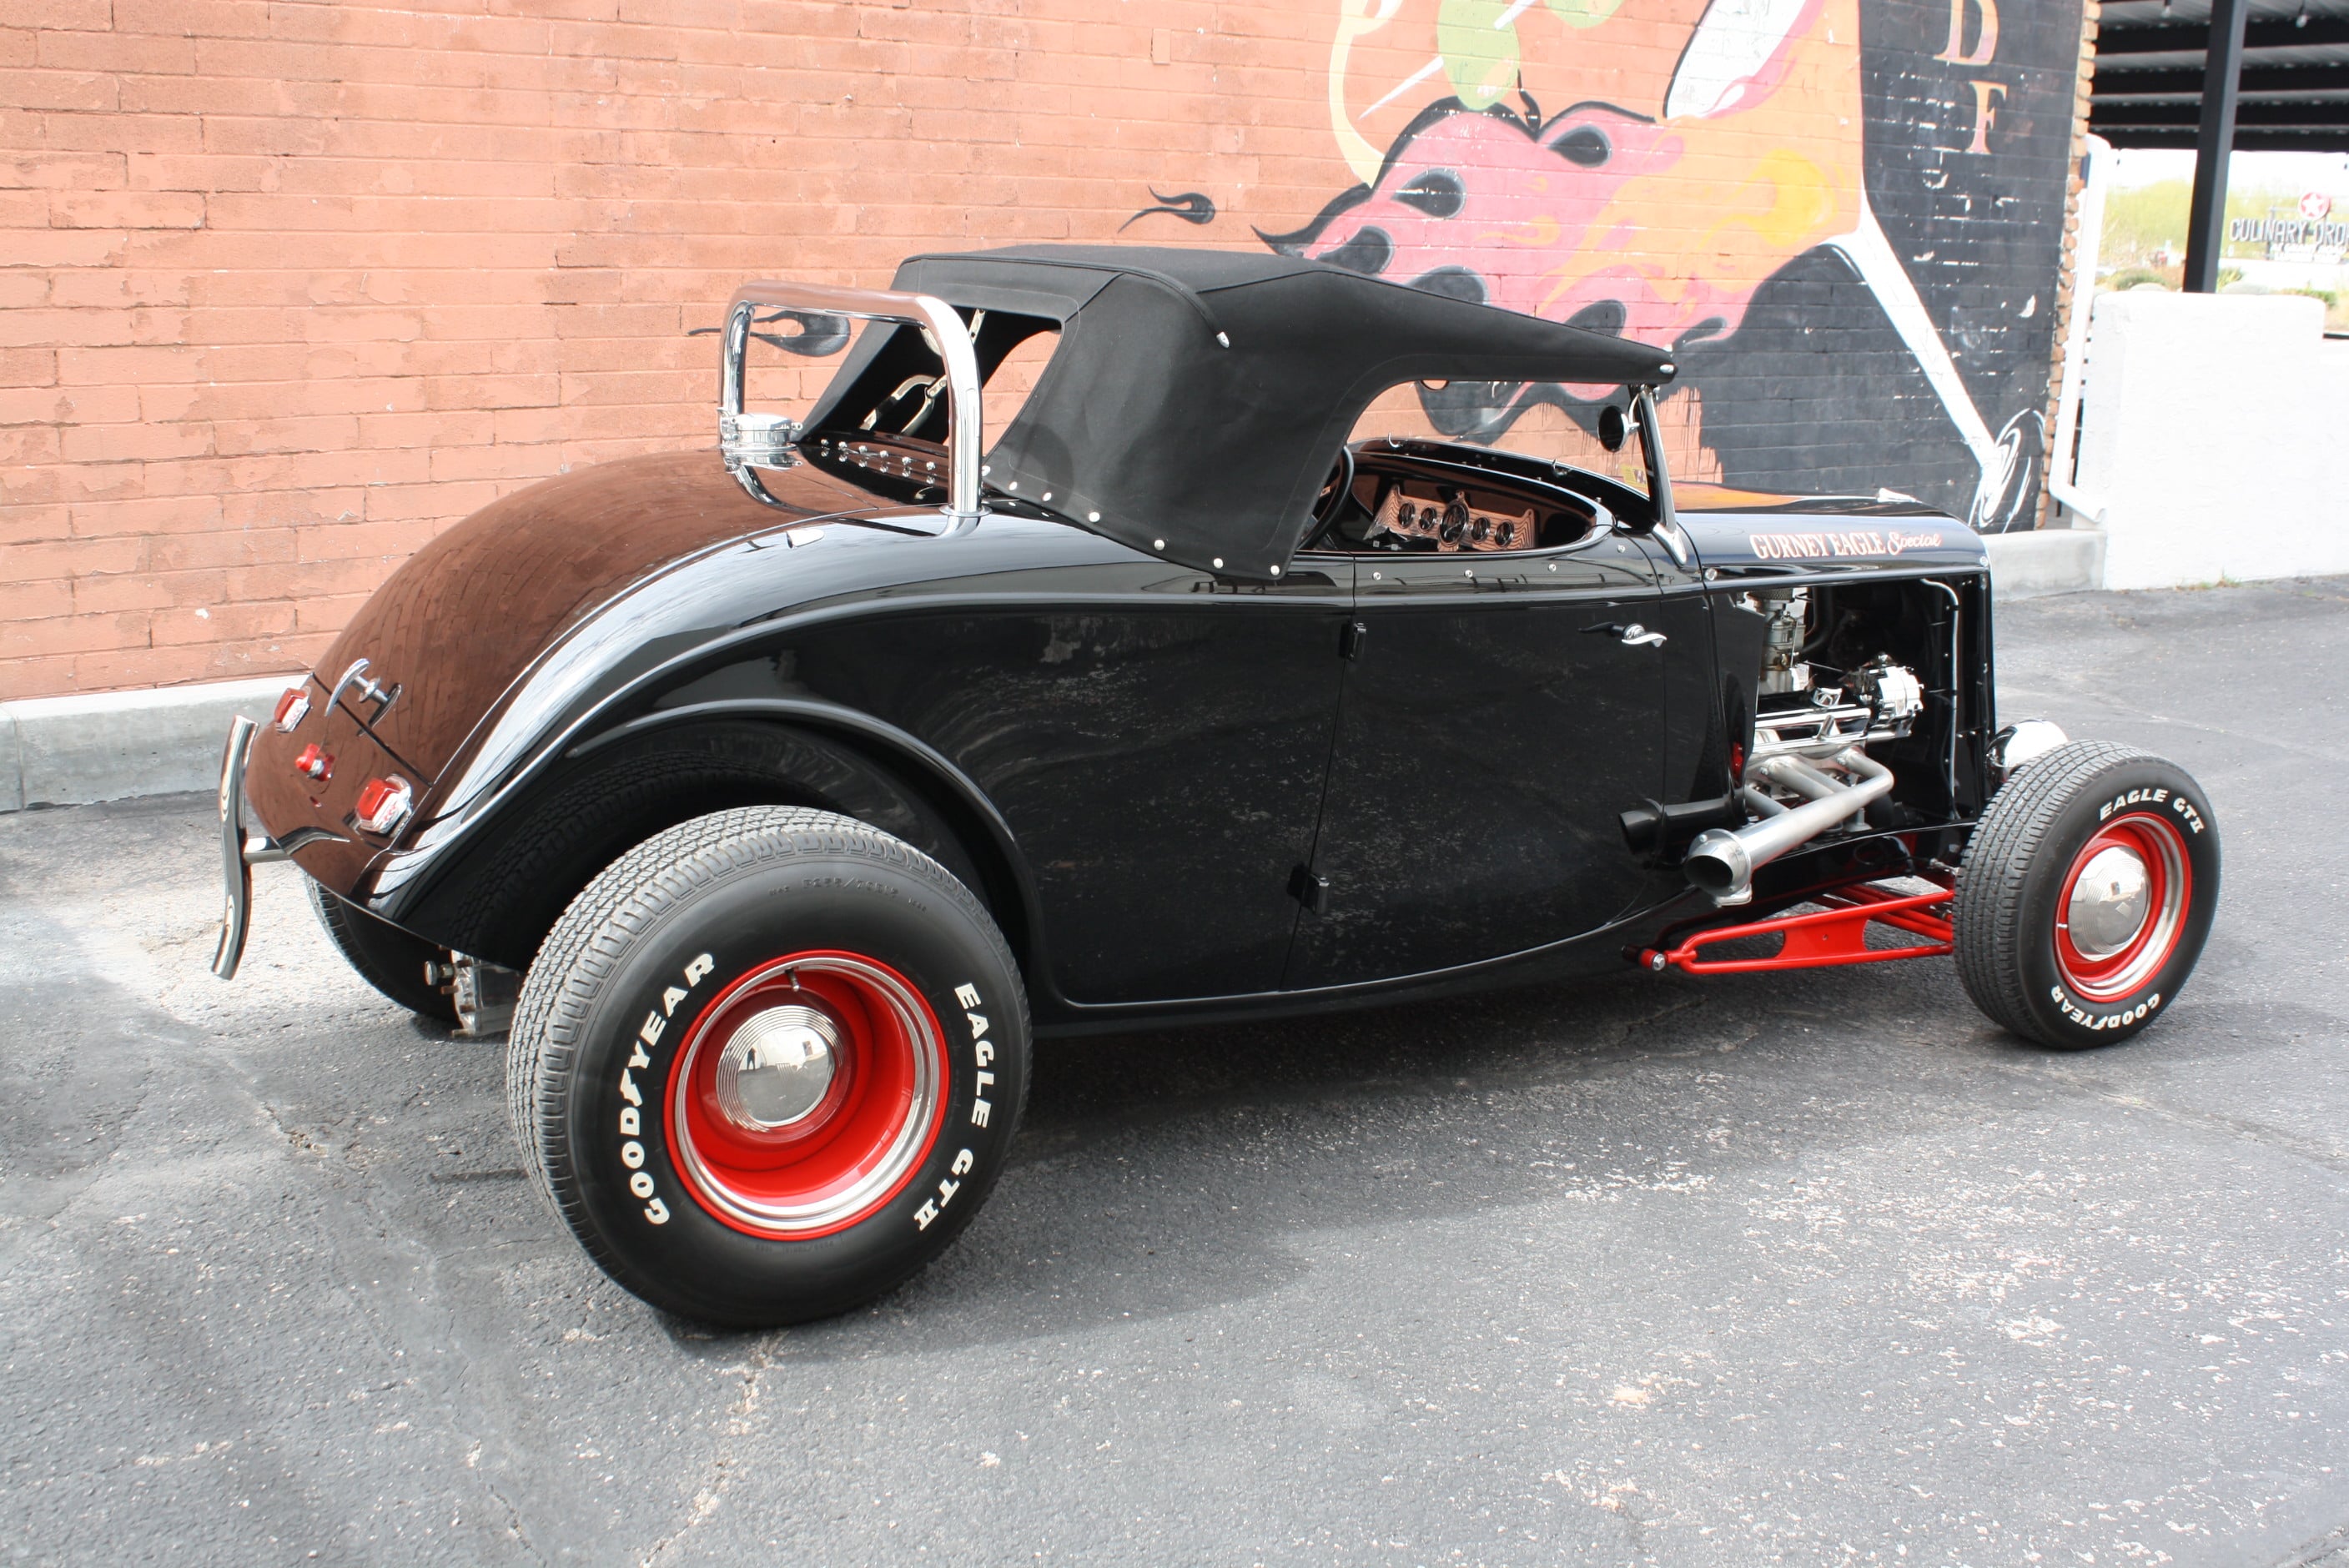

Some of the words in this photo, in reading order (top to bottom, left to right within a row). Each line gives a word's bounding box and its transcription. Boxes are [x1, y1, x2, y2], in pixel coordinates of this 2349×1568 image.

[1933, 0, 1999, 66] D
[1965, 80, 2008, 155] F
[2313, 220, 2349, 246] DRO
[1749, 533, 1831, 560] GURNEY
[1831, 531, 1886, 556] EAGLE
[1886, 530, 1943, 556] Special
[2099, 787, 2169, 822] EAGLE
[2050, 984, 2160, 1031] GOODYEAR
[953, 982, 994, 1129] EAGLE
[618, 952, 716, 1225] GOODYEAR
